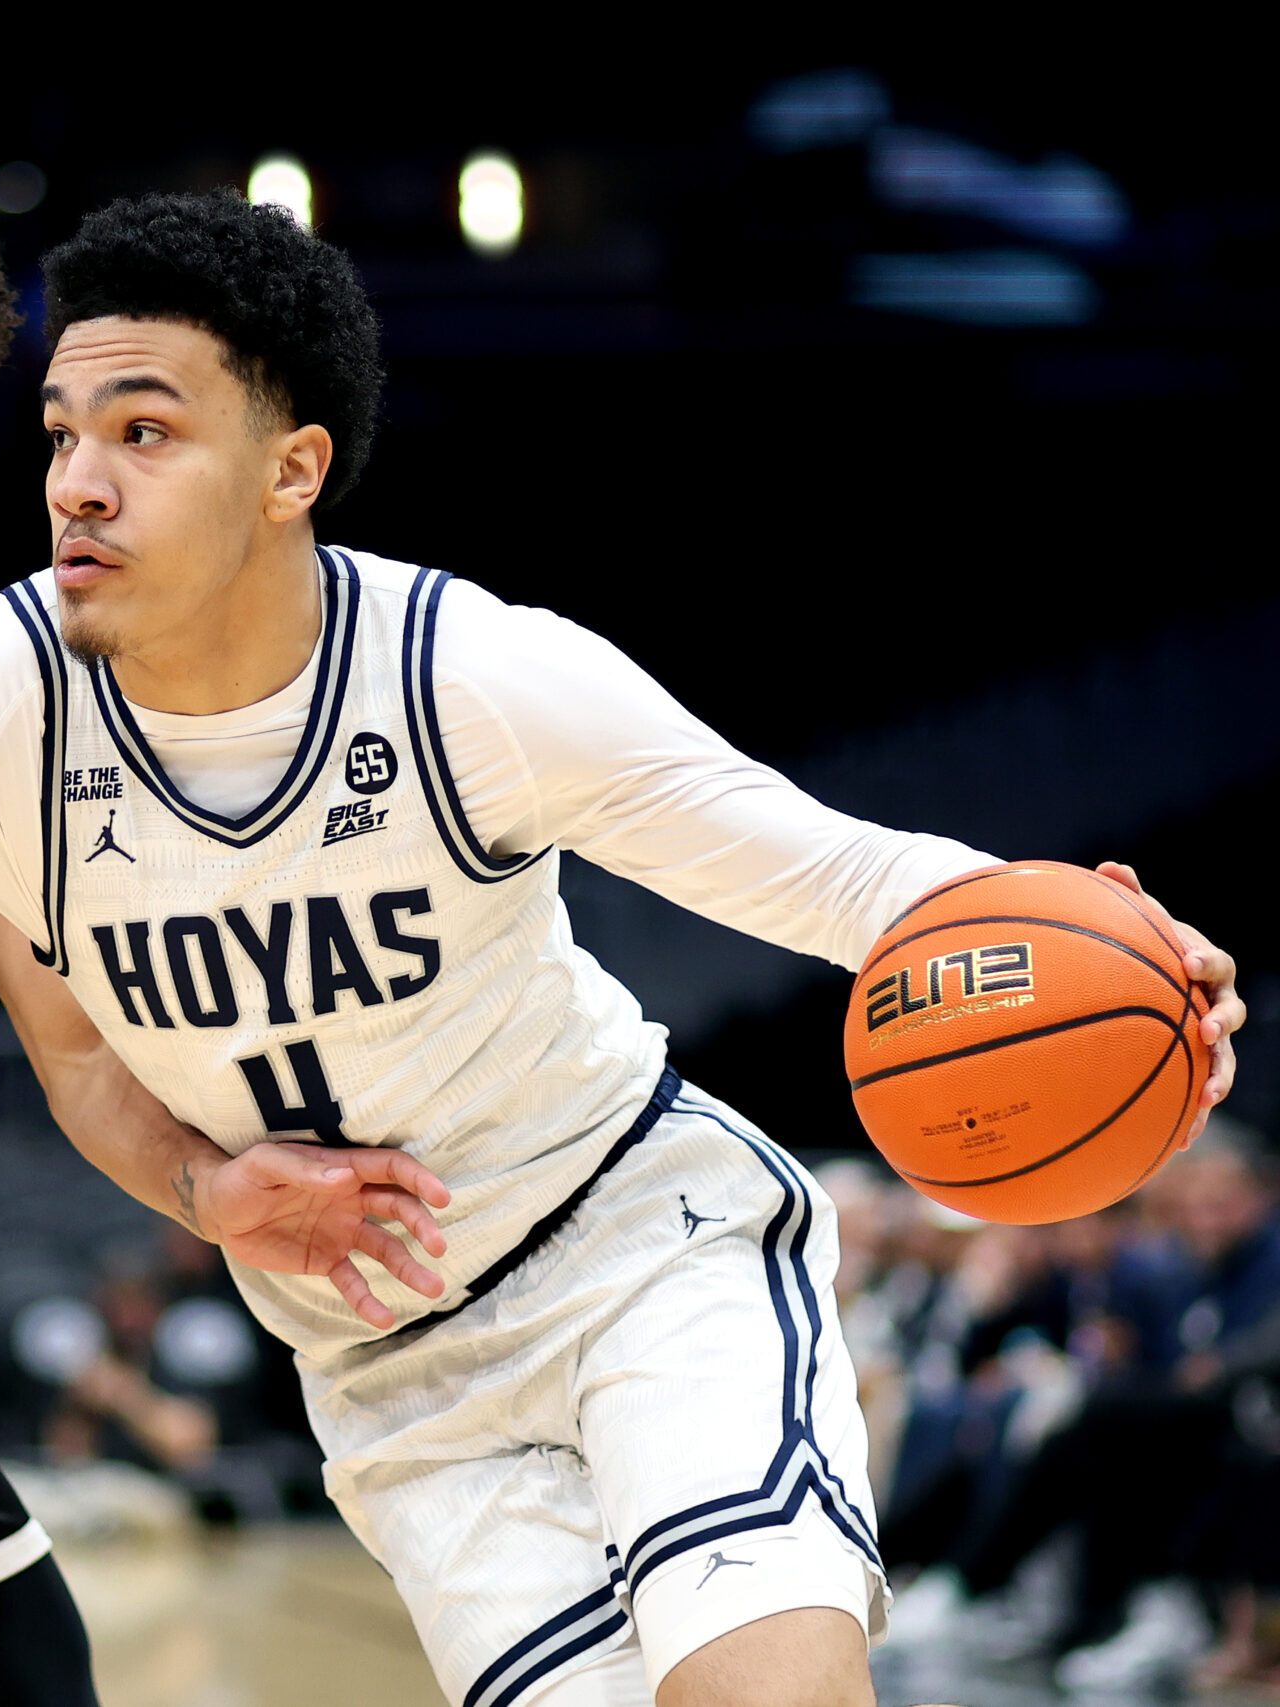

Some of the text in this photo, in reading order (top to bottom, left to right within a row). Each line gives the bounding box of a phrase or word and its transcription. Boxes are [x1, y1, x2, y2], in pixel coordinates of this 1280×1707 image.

[64, 766, 119, 786] BE THE
[351, 743, 389, 784] 55
[324, 809, 389, 838] EAST
[327, 799, 372, 823] BIG
[89, 885, 441, 1029] HOYAS
[867, 942, 1034, 1033] ELITE
[233, 1035, 348, 1146] 4
